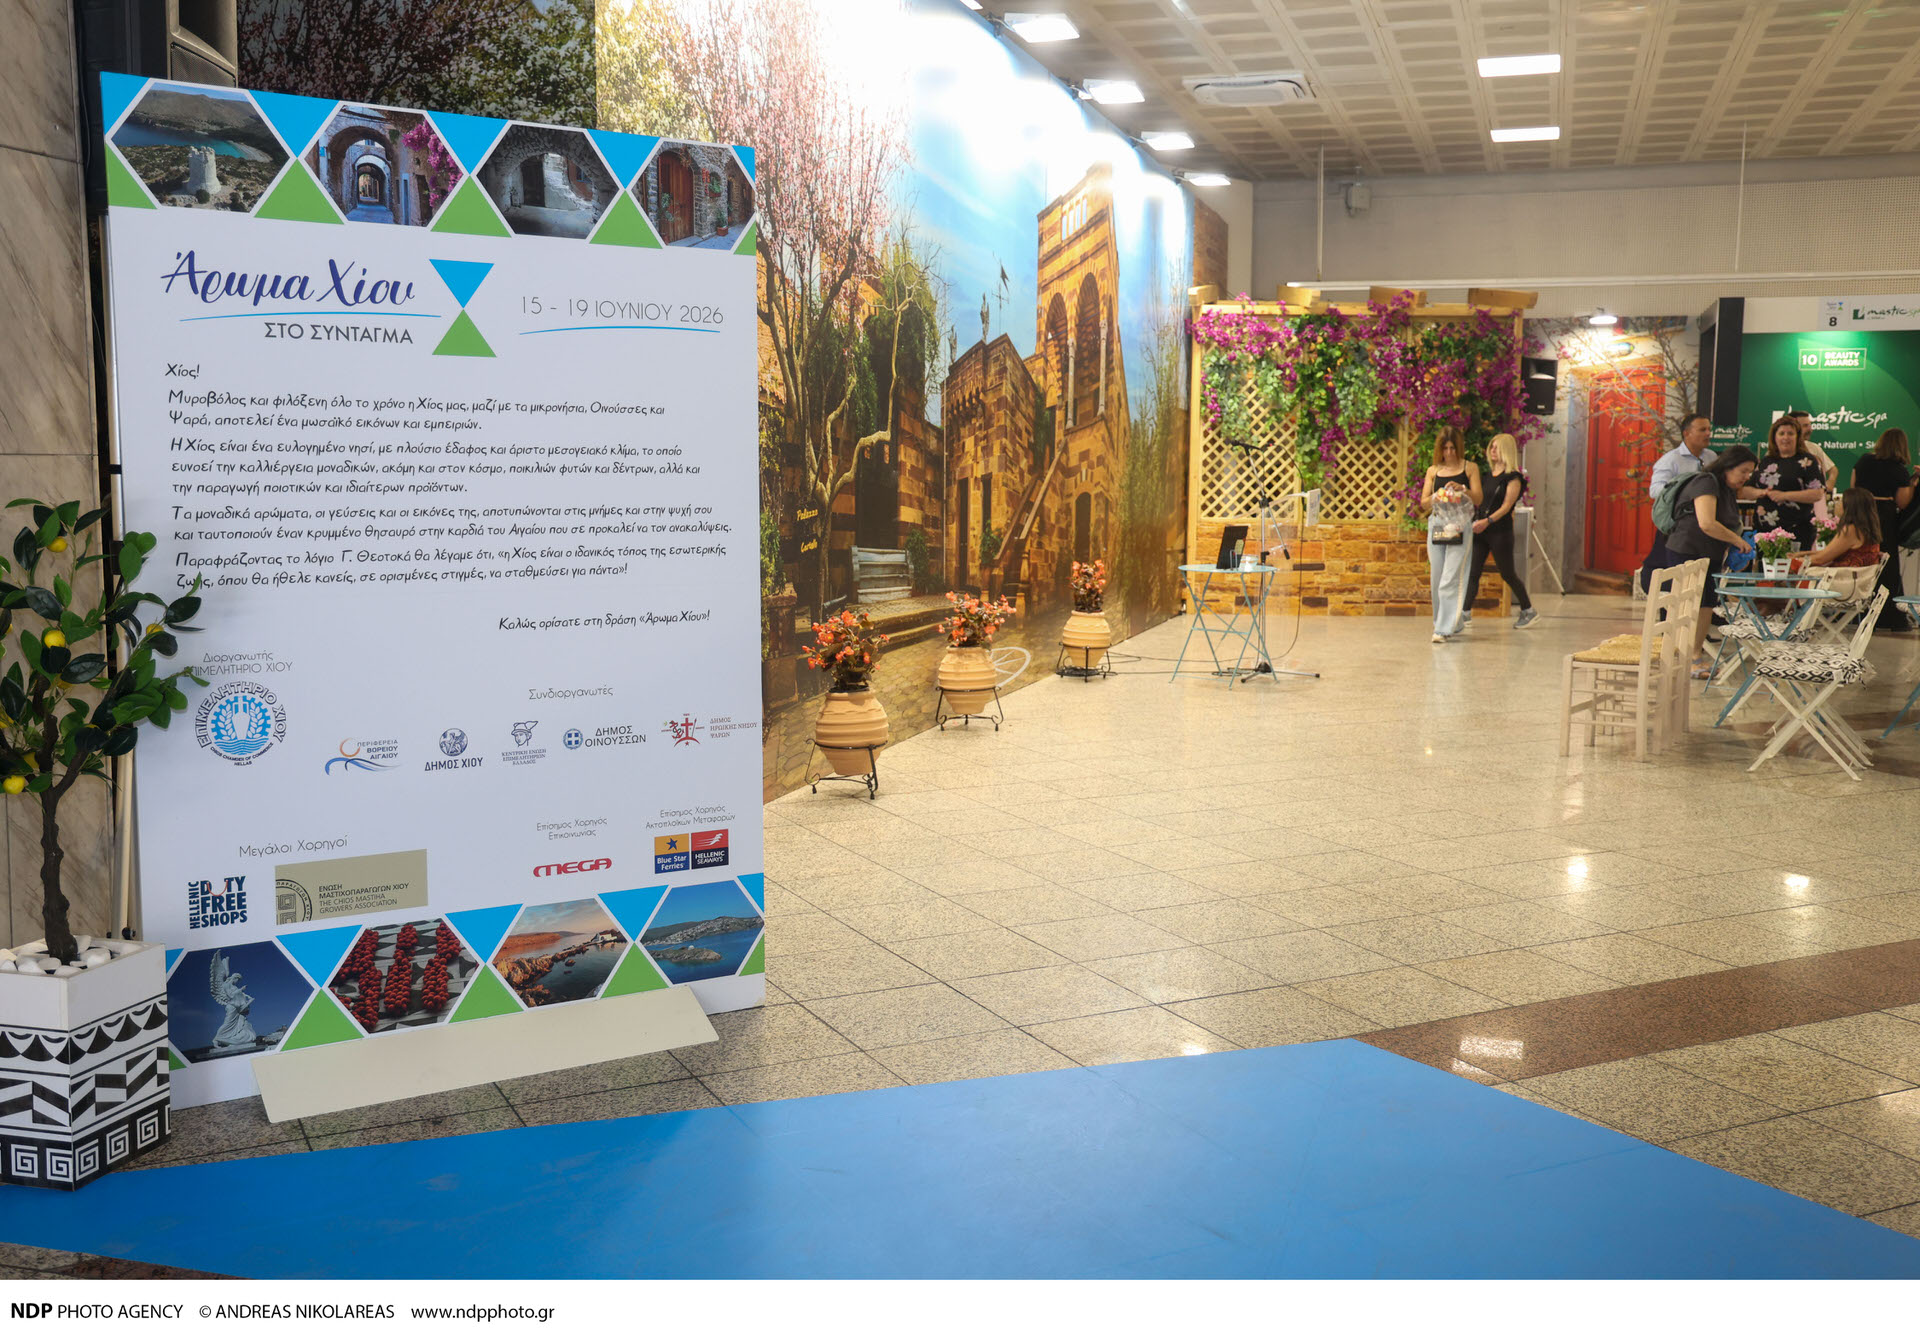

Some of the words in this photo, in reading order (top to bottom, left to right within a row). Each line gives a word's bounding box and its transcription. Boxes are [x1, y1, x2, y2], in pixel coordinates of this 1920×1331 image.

[161, 250, 316, 306] Άρωμα
[316, 258, 415, 306] Χίου
[522, 296, 542, 315] 15
[569, 298, 589, 317] 19
[595, 300, 673, 321] ΙΟΥΝΙΟΥ
[679, 304, 724, 324] 2026
[1867, 305, 1907, 316] mastic
[1829, 317, 1837, 327] 8
[264, 322, 304, 339] ΣΤΟ
[310, 324, 413, 344] ΣΥΝΤΑΓΜΑ
[1802, 354, 1818, 366] 10
[1824, 359, 1860, 367] AWARDS
[1825, 352, 1860, 360] BEAUTY
[165, 363, 200, 380] Χίος!
[168, 389, 247, 408] Μυροβόλος
[250, 396, 269, 406] και
[272, 393, 328, 411] φιλόξενη
[331, 395, 352, 408] όλο
[355, 399, 369, 408] το
[372, 397, 405, 411] χρόνο
[408, 401, 415, 412] η
[416, 397, 443, 412] Χίος
[446, 402, 469, 413] μας,
[472, 398, 497, 414] μαζί
[498, 402, 512, 414] με
[515, 403, 528, 412] τα
[530, 401, 587, 416] μικρονήσια,
[590, 401, 648, 416] Οινούσσες
[650, 406, 665, 415] και
[1864, 412, 1888, 429] spa
[1824, 441, 1857, 449] Natural
[172, 506, 192, 520] Τα
[195, 505, 250, 523] μοναδικά
[254, 507, 312, 522] αρώματα,
[315, 510, 325, 518] οι
[328, 506, 376, 521] γεύσεις
[379, 509, 397, 518] και
[412, 506, 455, 519] εικόνες
[458, 508, 480, 520] της,
[482, 505, 561, 517] αποτυπώνονται
[564, 507, 587, 517] στις
[588, 504, 623, 518] μνήμες
[625, 507, 640, 515] και
[643, 507, 666, 517] στην
[668, 503, 692, 517] ψυχή
[176, 552, 283, 569] Παραφράζοντας
[286, 555, 300, 564] το
[304, 551, 334, 567] λόγιο
[341, 549, 353, 562] Γ.
[356, 549, 411, 563] Θεοτοκά
[414, 548, 430, 561] θα
[433, 548, 473, 563] λέγαμε
[476, 549, 495, 560] ότι,
[498, 551, 510, 562] «η
[511, 547, 537, 560] Χίος
[540, 546, 563, 558] είναι
[565, 550, 572, 558] ο
[574, 545, 615, 558] ιδανικός
[617, 546, 647, 558] τόπος
[650, 548, 666, 558] της
[669, 543, 726, 557] εσωτερικής
[217, 574, 248, 586] όπου
[251, 571, 269, 585] θα
[272, 571, 311, 588] ήθελε
[315, 570, 356, 584] κανείς,
[359, 572, 376, 582] σε
[379, 568, 438, 584] ορισμένες
[441, 567, 487, 582] στιγμές,
[489, 570, 502, 578] να
[504, 564, 569, 580] σταθμεύσει
[571, 568, 587, 579] για
[589, 562, 628, 575] πάντα»!
[499, 617, 536, 631] Καλώς
[539, 616, 581, 631] ορίσατε
[583, 618, 603, 628] στη
[605, 613, 637, 628] δράση
[639, 612, 678, 626] «Άρωμα
[679, 609, 710, 622] Χίου»!
[203, 650, 274, 664] Διοργανωτής
[265, 661, 293, 672] ΧΙΟΥ
[528, 684, 613, 700] Συνδιοργανωτές
[195, 681, 277, 749] ΕΠΙΜΕΛΗΤΗΡΙΟ
[272, 704, 287, 743] ΧΙΟΥ
[596, 726, 632, 736] ΔΗΜΟΣ
[584, 734, 646, 747] ΟΙΝΟΥΣΣΩΝ
[424, 759, 459, 771] ΔΗΜΟΣ
[461, 757, 483, 768] ΧΙΟΥ
[660, 808, 693, 818] Επίσημος
[695, 805, 726, 815] Χορηγός
[536, 821, 572, 831] Επίσημος
[574, 816, 608, 827] Χορηγός
[548, 828, 596, 841] Επικοινωνίας
[239, 842, 292, 858] Μεγάλοι
[297, 834, 348, 852] Χορηγοί
[695, 851, 725, 859] HELLENIC
[533, 858, 612, 878] MEGA
[319, 884, 342, 892] ΕΝΩΣΗ
[319, 885, 391, 899] ΜΑΣΤΙΧΟΠΑΡΑΓΩΓΩΝ
[188, 881, 201, 929] HELLENIC
[200, 892, 247, 914] FREE
[320, 904, 352, 913] GROWERS
[354, 898, 397, 909] ASSOCIATION
[333, 897, 354, 905] CHIOS
[356, 893, 385, 902] MASTIHA
[201, 910, 248, 928] SHOPS
